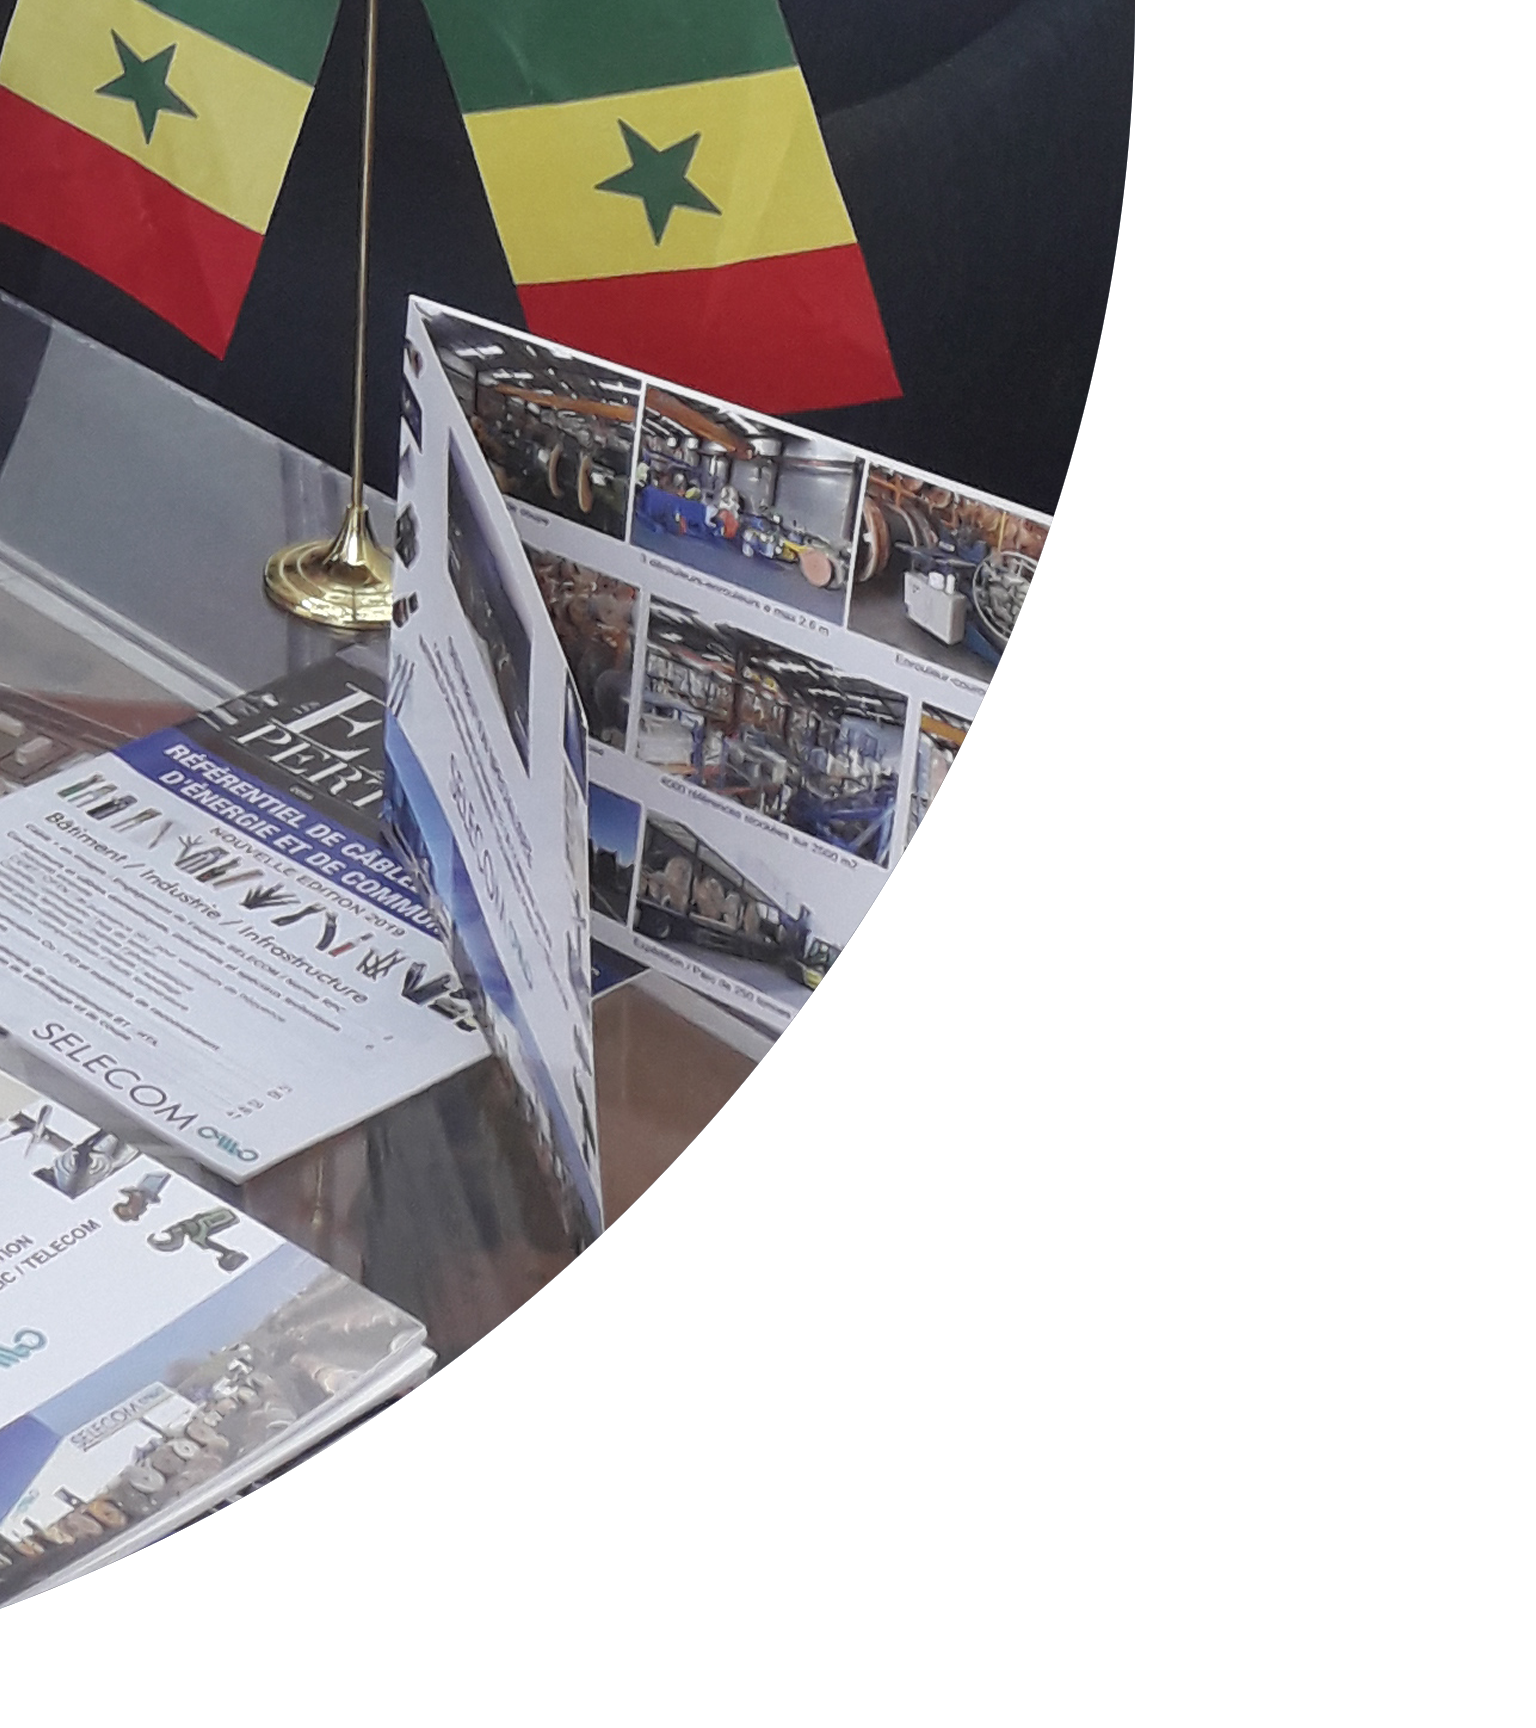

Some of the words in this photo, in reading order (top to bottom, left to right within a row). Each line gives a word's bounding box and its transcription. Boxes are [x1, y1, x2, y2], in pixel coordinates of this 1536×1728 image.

[164, 744, 307, 830] RÉFÉRENTIEL
[306, 824, 345, 848] DE
[158, 771, 282, 839] D'ÉNERGIE
[274, 834, 314, 856] ET
[305, 853, 345, 877] DE
[341, 870, 439, 935] COMMU
[210, 826, 290, 876] NOUVELLE
[295, 872, 364, 916] EDITION
[364, 913, 406, 939] 2019
[45, 812, 129, 865] Bâtiment
[139, 868, 222, 920] Industrie
[238, 925, 369, 1005] Infrastructure
[31, 1022, 199, 1132] SELECOM
[20, 1219, 103, 1273] TELECOM
[70, 1398, 141, 1448] SELECOM
